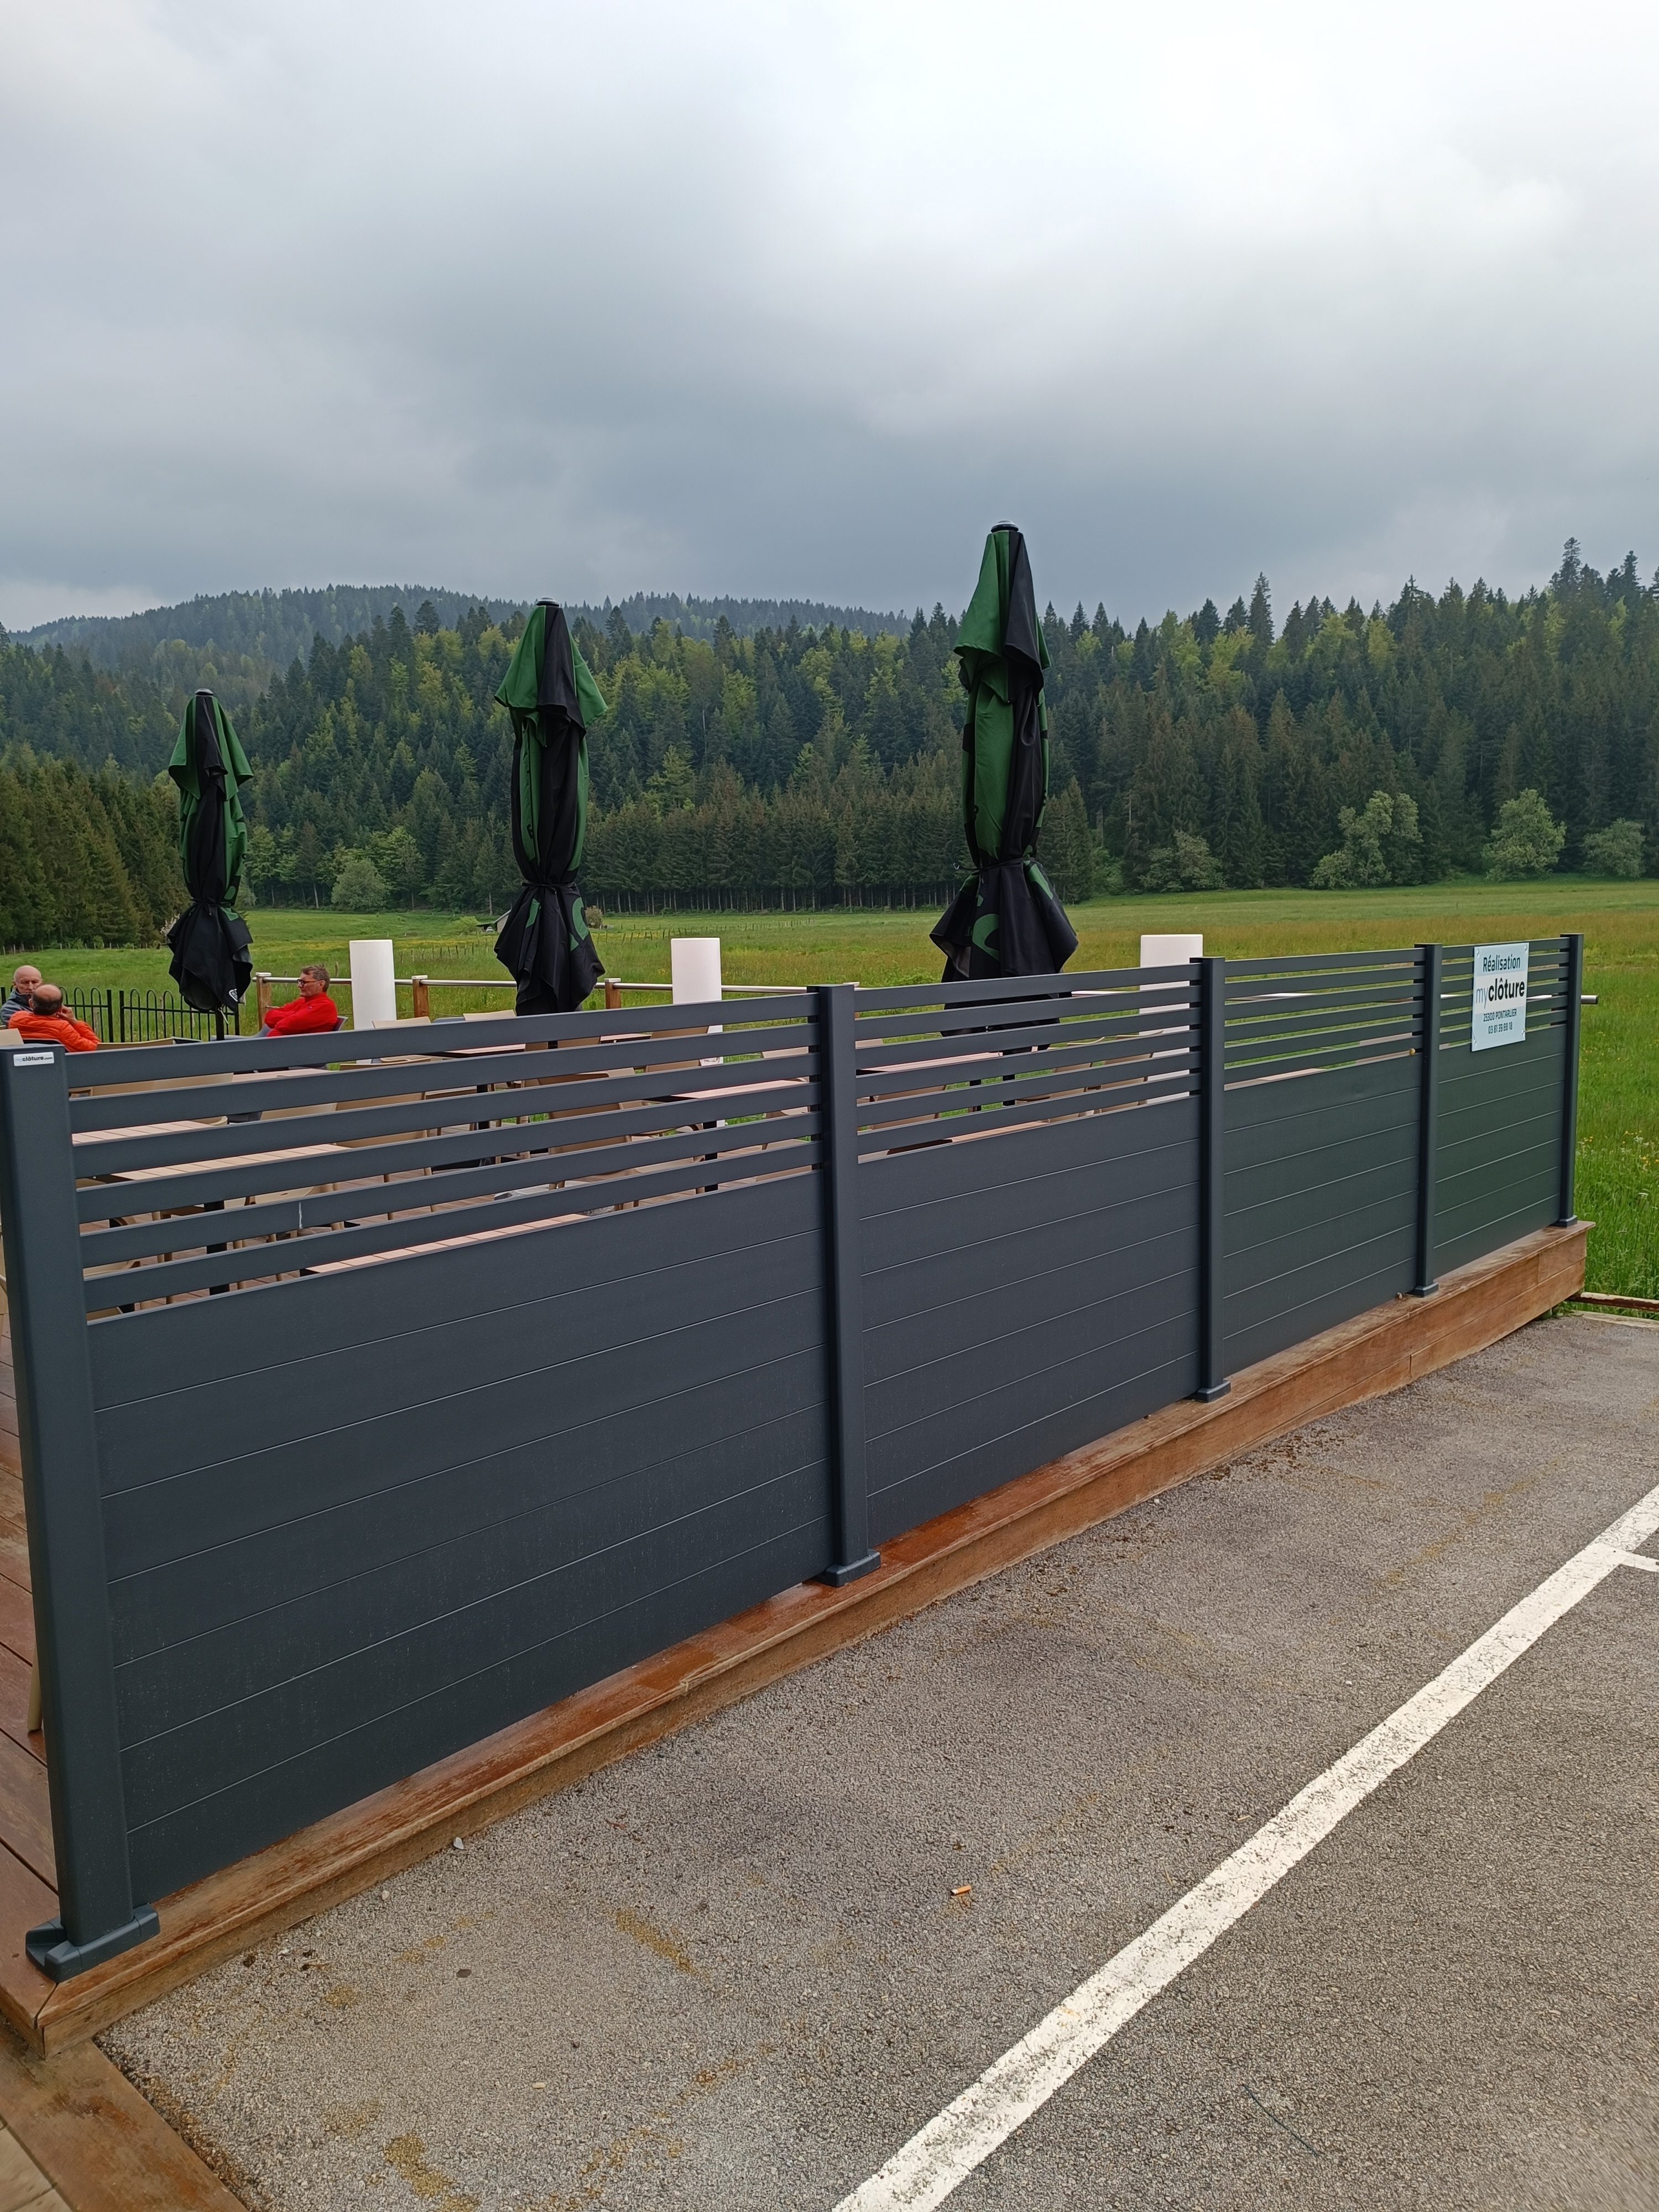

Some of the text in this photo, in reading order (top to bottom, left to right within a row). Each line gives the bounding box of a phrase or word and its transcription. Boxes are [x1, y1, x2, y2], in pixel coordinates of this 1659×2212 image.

[1483, 954, 1520, 972] Réalisation
[1476, 978, 1525, 1009] myclôture
[1483, 1009, 1517, 1022] 25300 PONTARLIER
[1488, 1026, 1493, 1034] 03
[1494, 1024, 1498, 1033] 81
